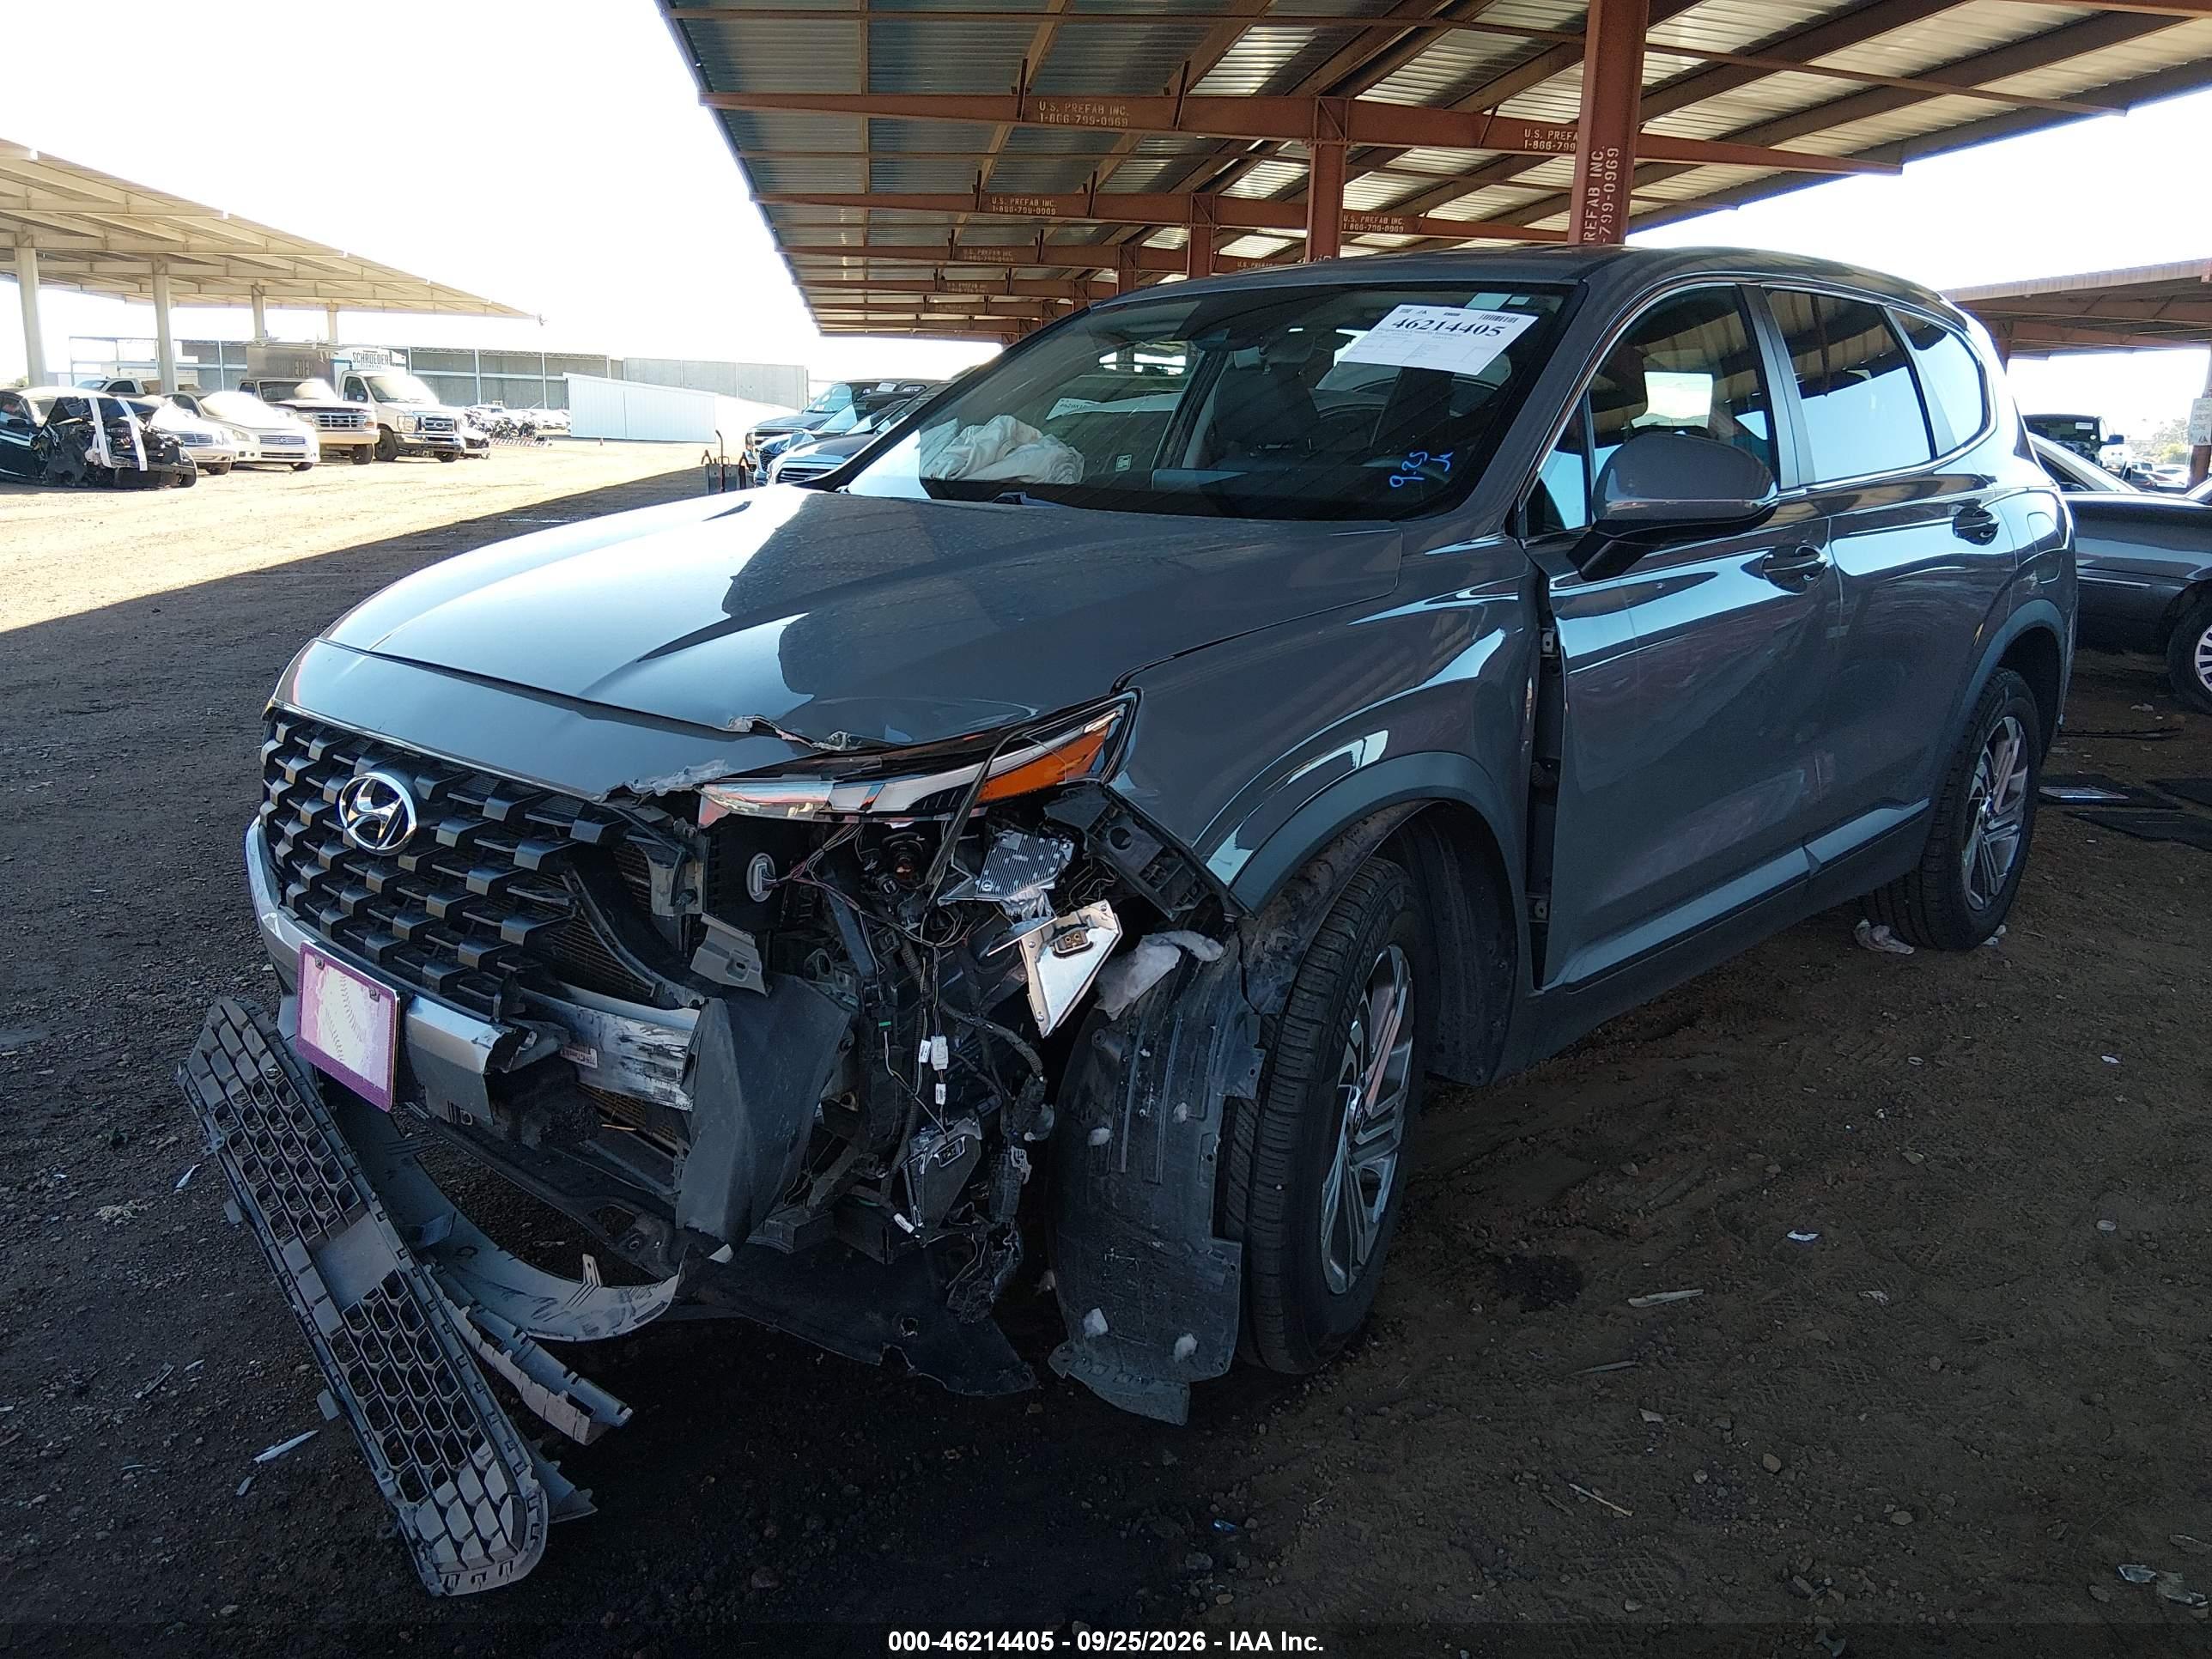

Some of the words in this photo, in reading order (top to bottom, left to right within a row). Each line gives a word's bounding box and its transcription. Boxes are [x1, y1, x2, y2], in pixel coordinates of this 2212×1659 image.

[1065, 102, 1104, 114] PREFAB
[1524, 128, 1543, 139] U.S.
[1547, 130, 1578, 141] PREFA
[1524, 139, 1576, 151] 1-866-799
[1589, 145, 1605, 178] INC.
[1583, 186, 1601, 241] REFAB
[1391, 318, 1505, 337] 46214405
[352, 351, 389, 366] SCHROEDER
